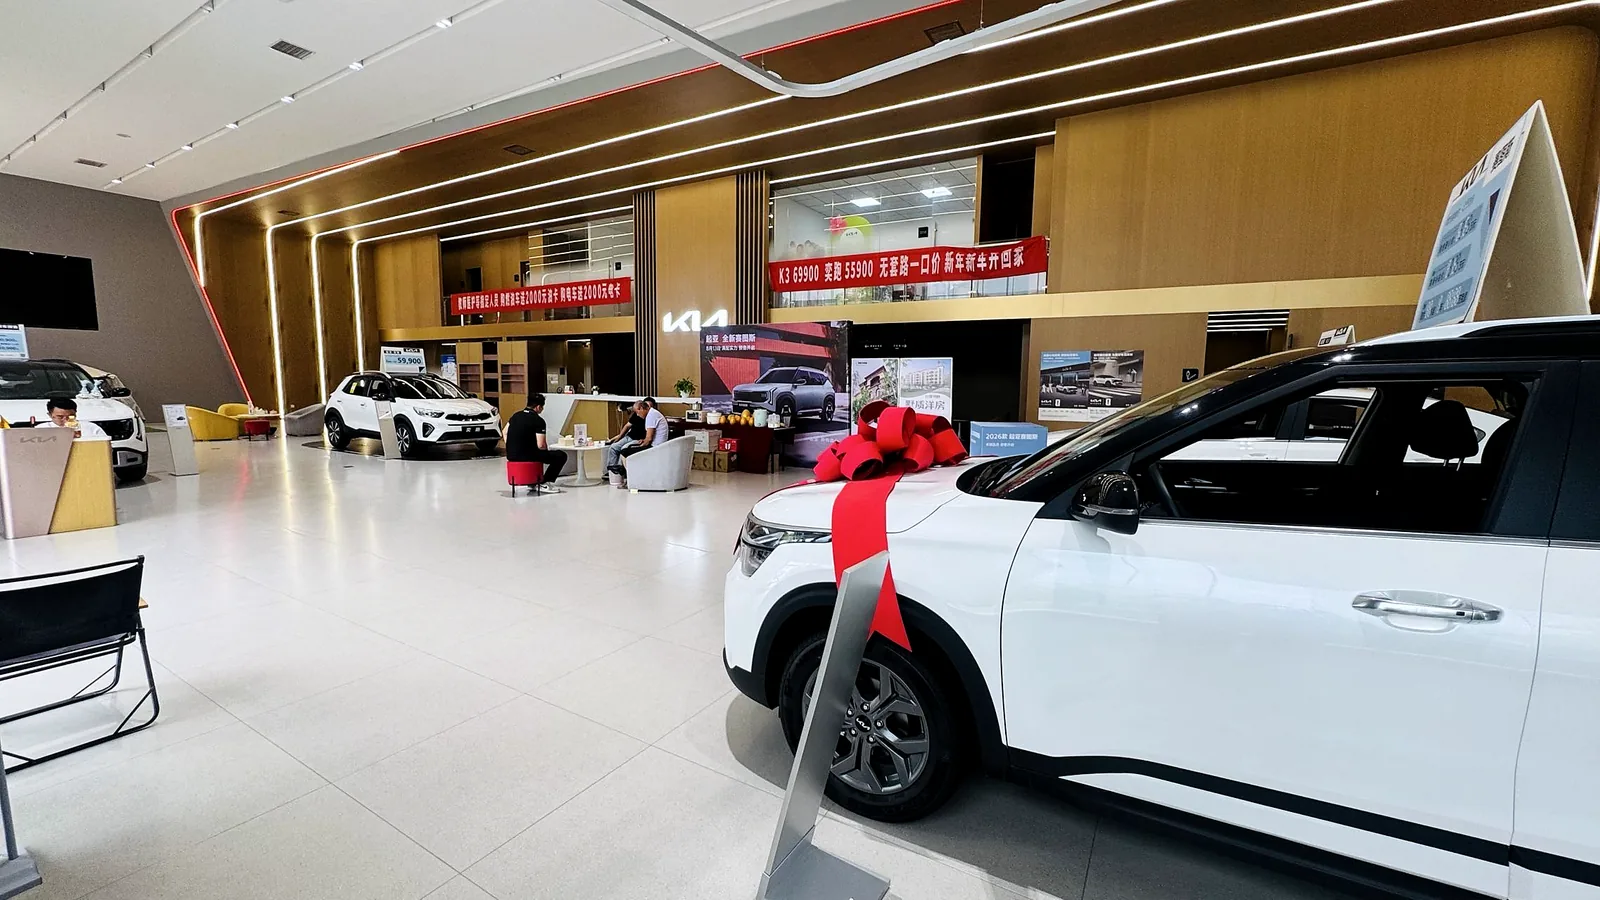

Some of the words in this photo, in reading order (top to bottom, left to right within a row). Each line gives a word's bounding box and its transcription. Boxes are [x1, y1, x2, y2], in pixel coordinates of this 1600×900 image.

[779, 267, 790, 284] K3
[793, 264, 819, 283] 69900
[824, 261, 842, 283] 奕跑
[845, 259, 873, 278] 55900
[879, 254, 941, 277] 无套路一口价
[944, 246, 1025, 273] 新年新车开回家
[560, 282, 621, 303] 购电车送2000元电卡
[663, 309, 728, 332] KIA
[722, 333, 756, 343] 全新赛图斯
